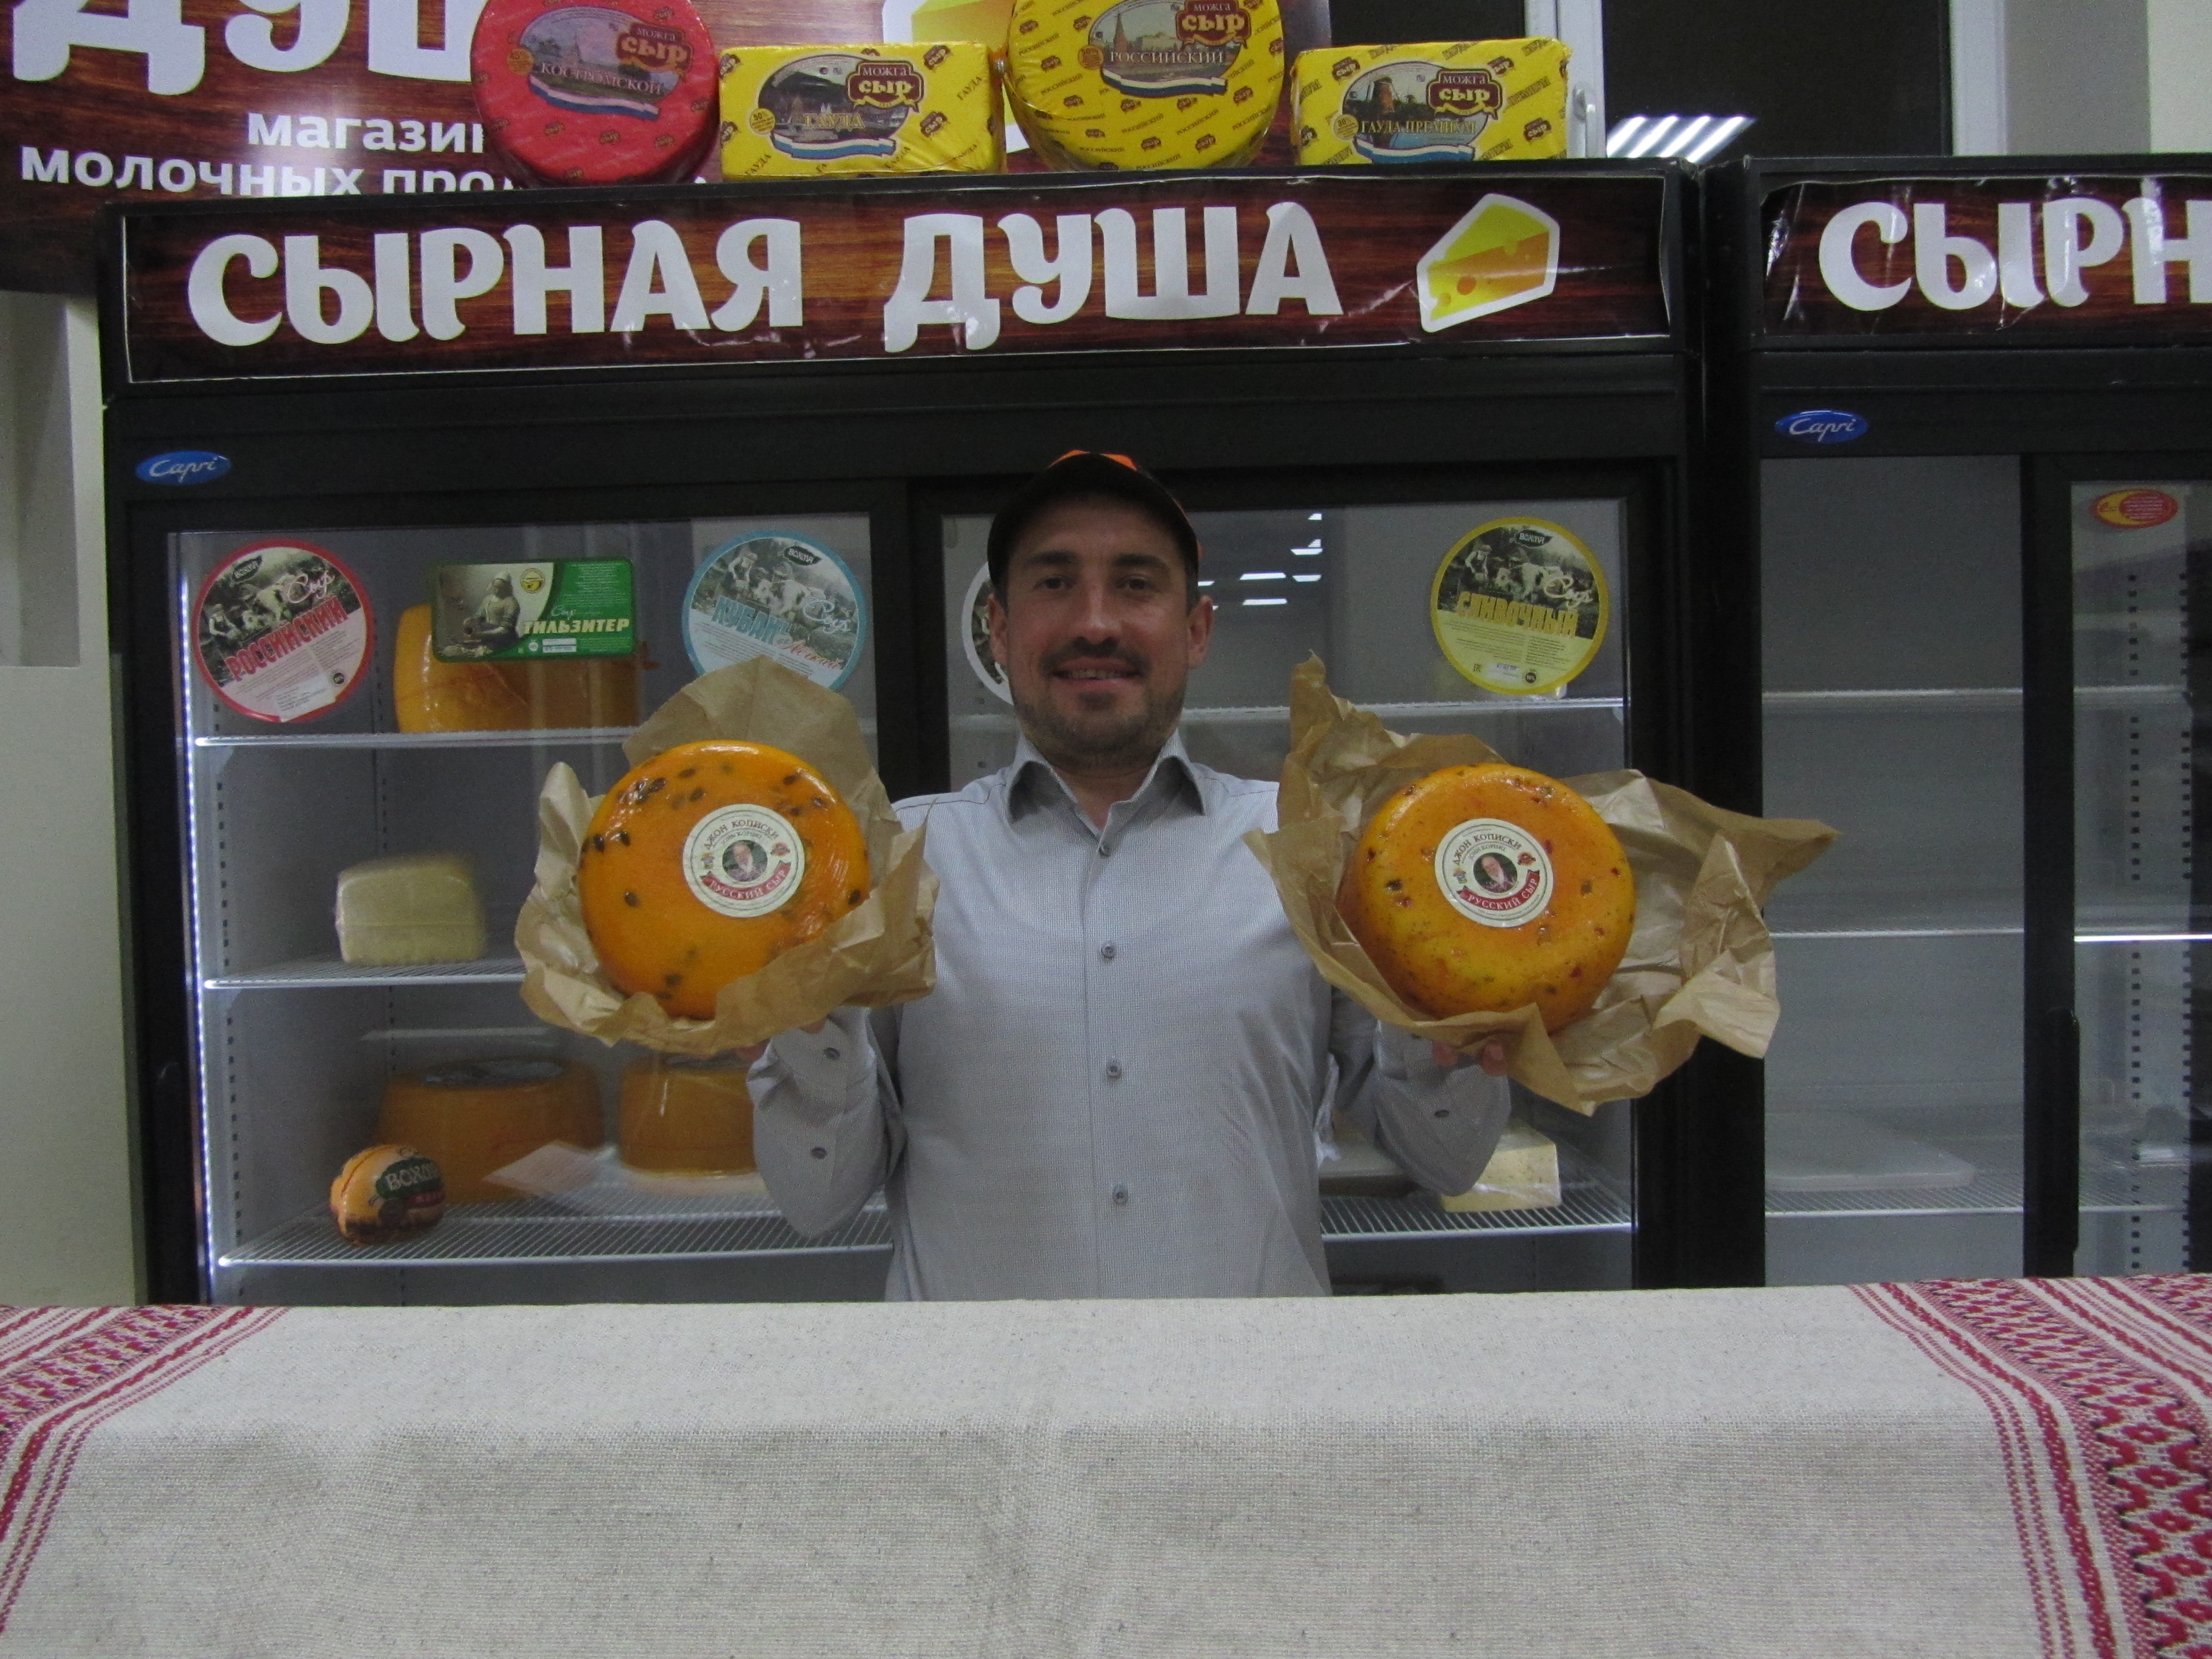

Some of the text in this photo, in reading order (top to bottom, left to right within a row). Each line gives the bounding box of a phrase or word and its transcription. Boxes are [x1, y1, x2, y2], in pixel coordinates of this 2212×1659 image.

[1110, 49, 1224, 64] РОССИЙСКИЙ
[805, 113, 866, 132] ГАУДА
[1361, 120, 1401, 133] ГАУДА
[1405, 120, 1475, 134] ПРЕМИУМ
[20, 145, 513, 197] молочных про
[1819, 197, 2212, 311] СЫРН
[187, 201, 1344, 352] СЫРНАЯ ДУША
[1789, 418, 1856, 442] Capri
[149, 457, 218, 482] Capri
[224, 595, 349, 682] РОССИЙСКИЙ
[523, 618, 630, 634] ТИЛЬЗИТЕР
[1473, 833, 1522, 851] КОПИСКИ
[709, 868, 787, 900] РУССКИЙ СЫР
[1468, 878, 1537, 910] РУССКИЙ СЫР
